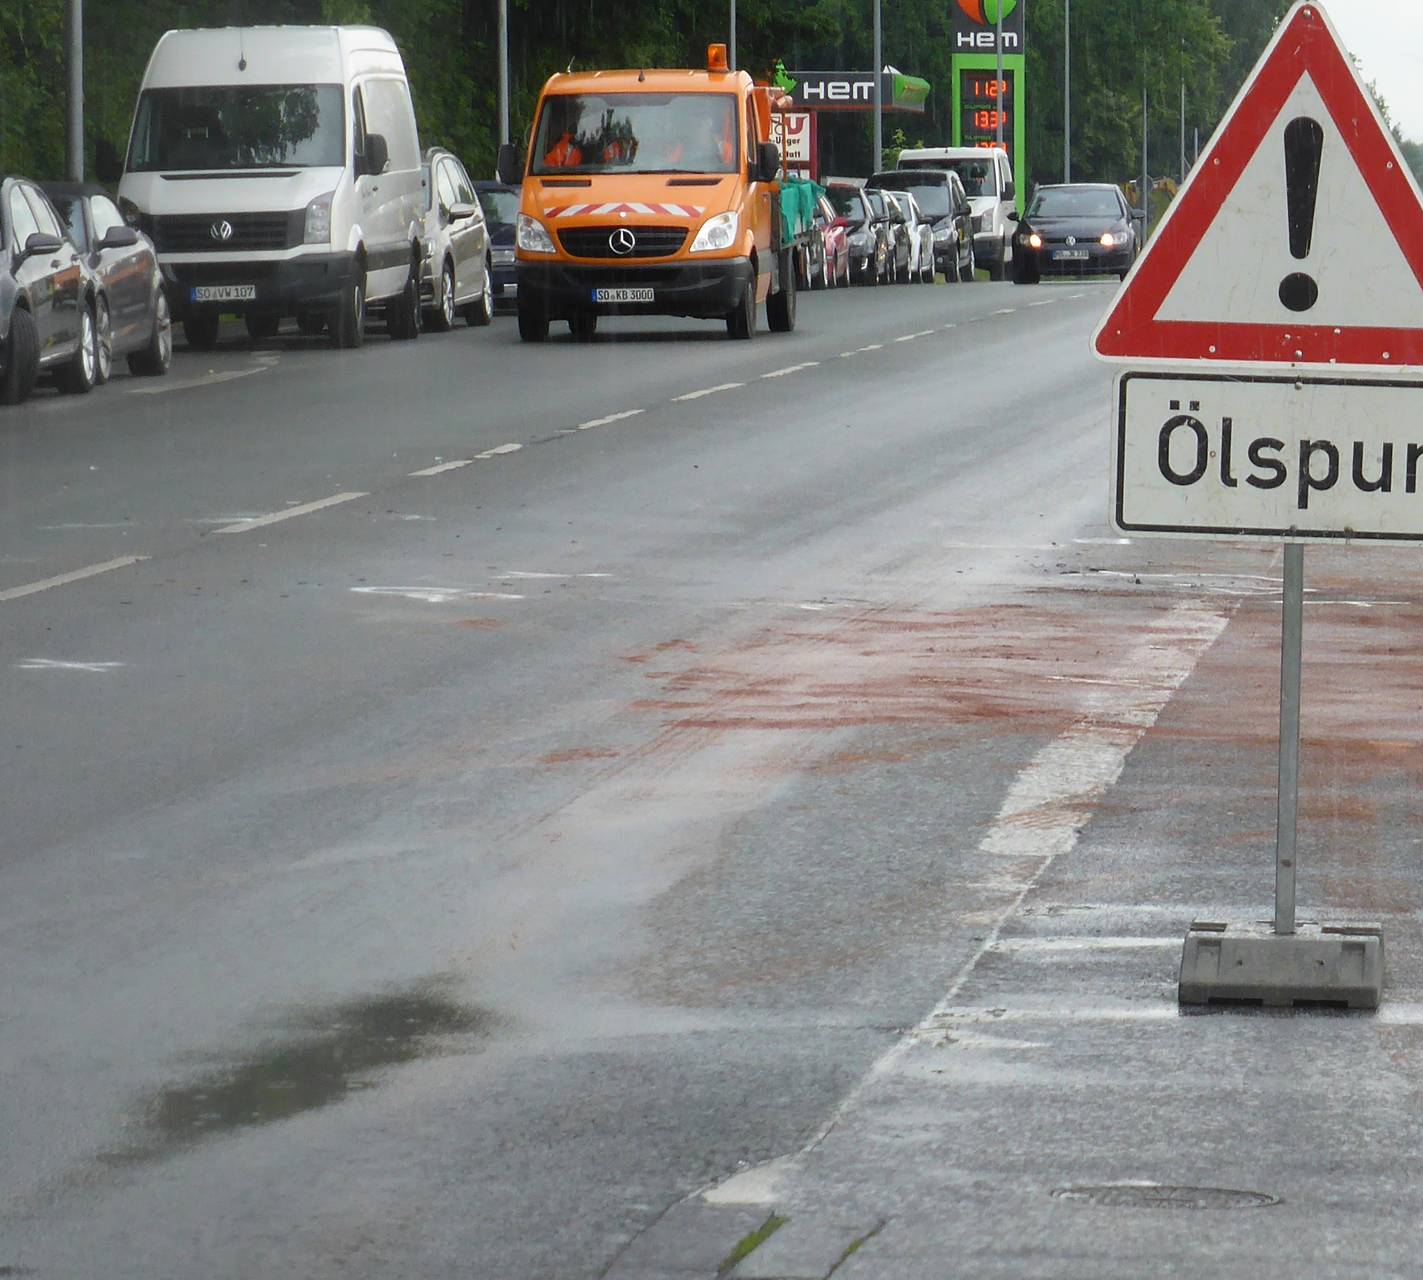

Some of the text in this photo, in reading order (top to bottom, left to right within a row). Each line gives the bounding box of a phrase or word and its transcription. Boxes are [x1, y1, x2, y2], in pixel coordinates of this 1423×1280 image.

[234, 286, 254, 298] 107
[598, 290, 610, 301] SO
[630, 289, 653, 301] 3000
